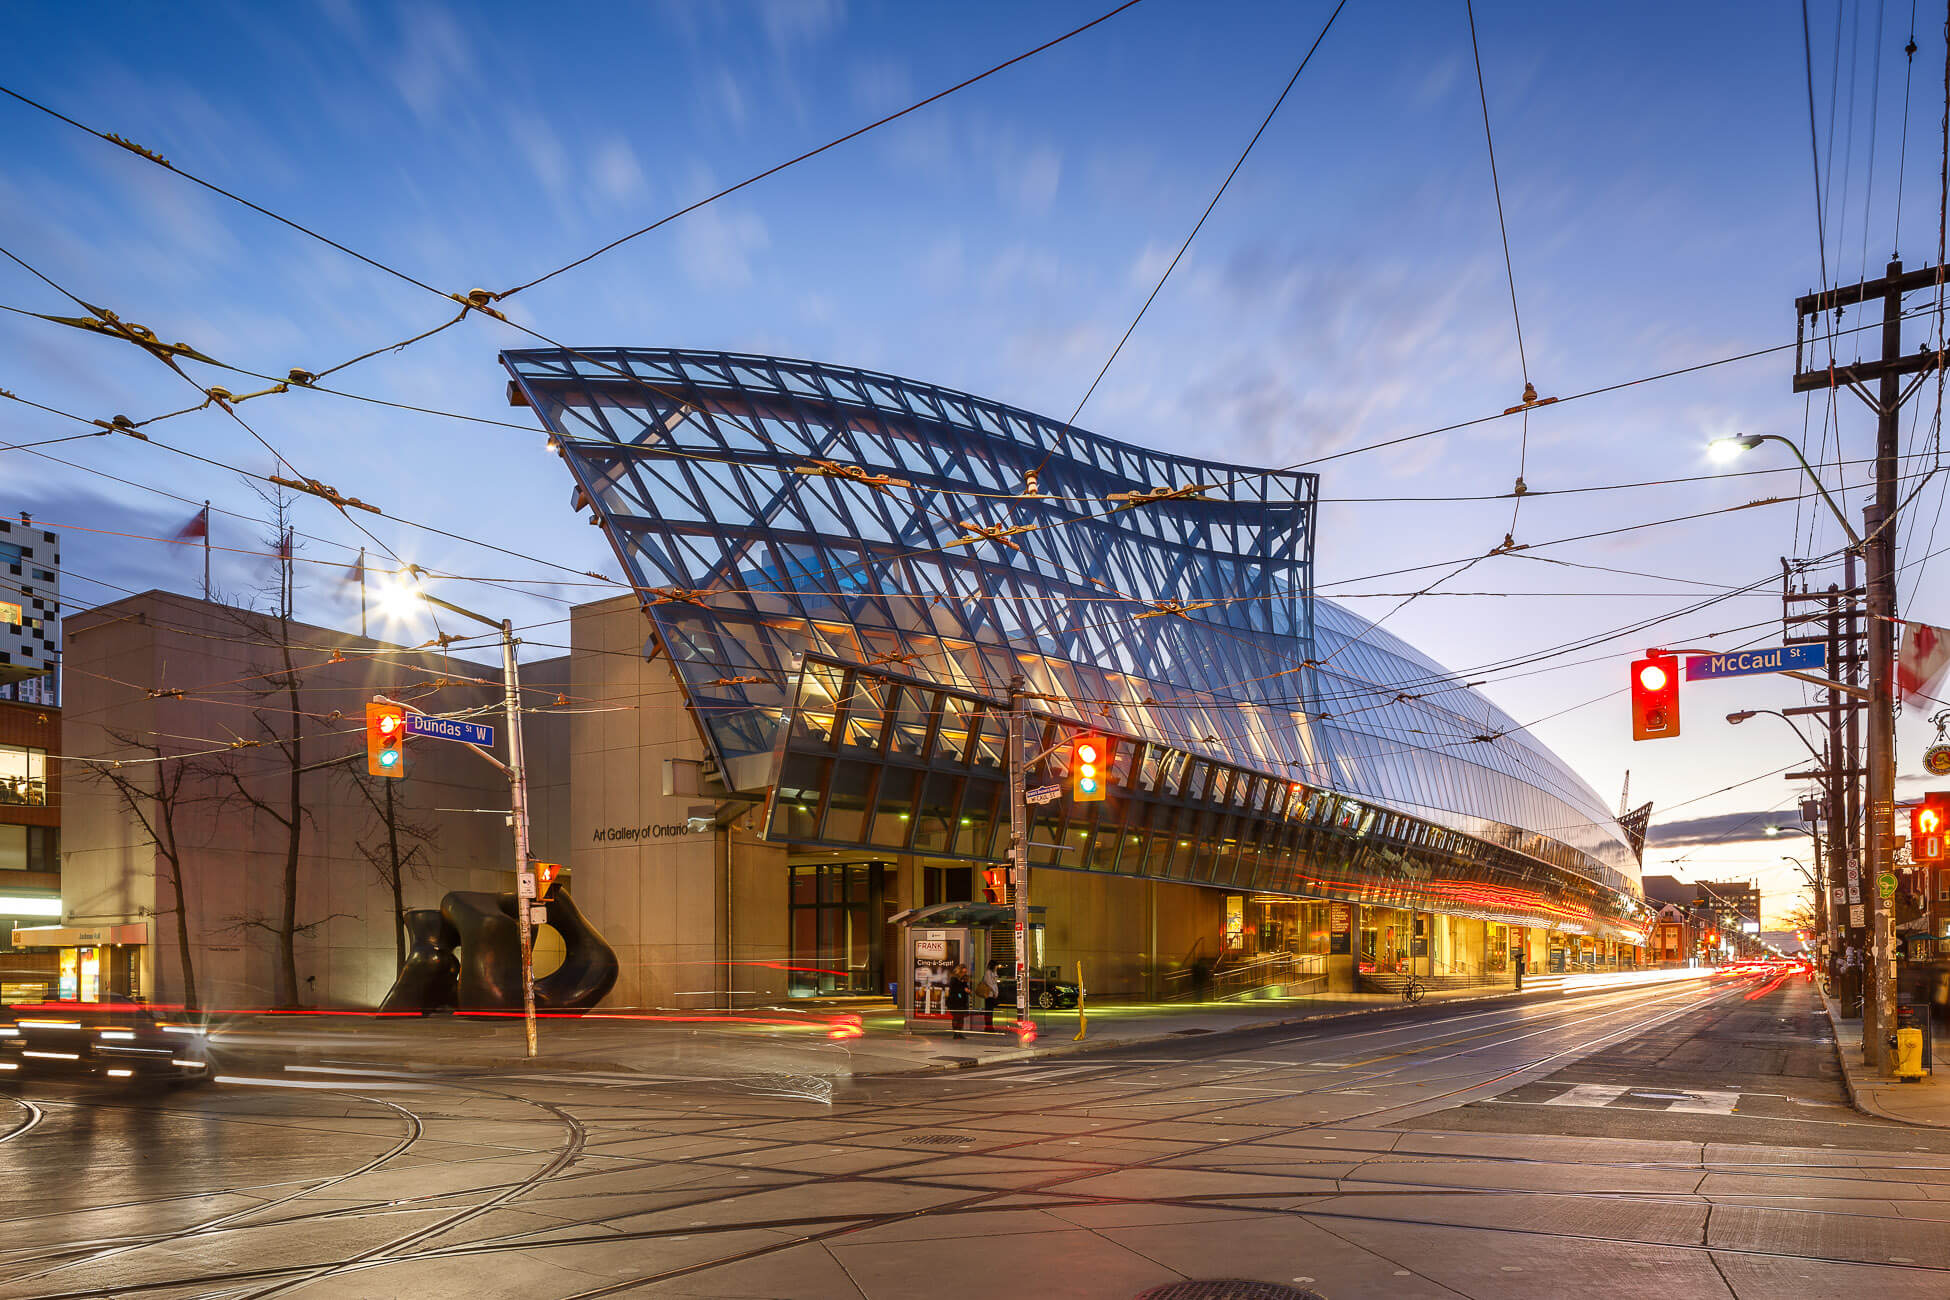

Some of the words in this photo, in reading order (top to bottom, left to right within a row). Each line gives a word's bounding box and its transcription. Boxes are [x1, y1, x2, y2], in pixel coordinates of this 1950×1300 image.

[1711, 650, 1782, 673] McCaul
[1789, 648, 1801, 658] St
[414, 715, 461, 737] Dundas
[465, 725, 472, 733] St
[476, 726, 487, 741] W
[593, 829, 605, 842] Art
[607, 827, 640, 842] Gallery
[641, 825, 650, 839] of
[652, 823, 688, 838] Ontario
[917, 942, 943, 950] FRANK
